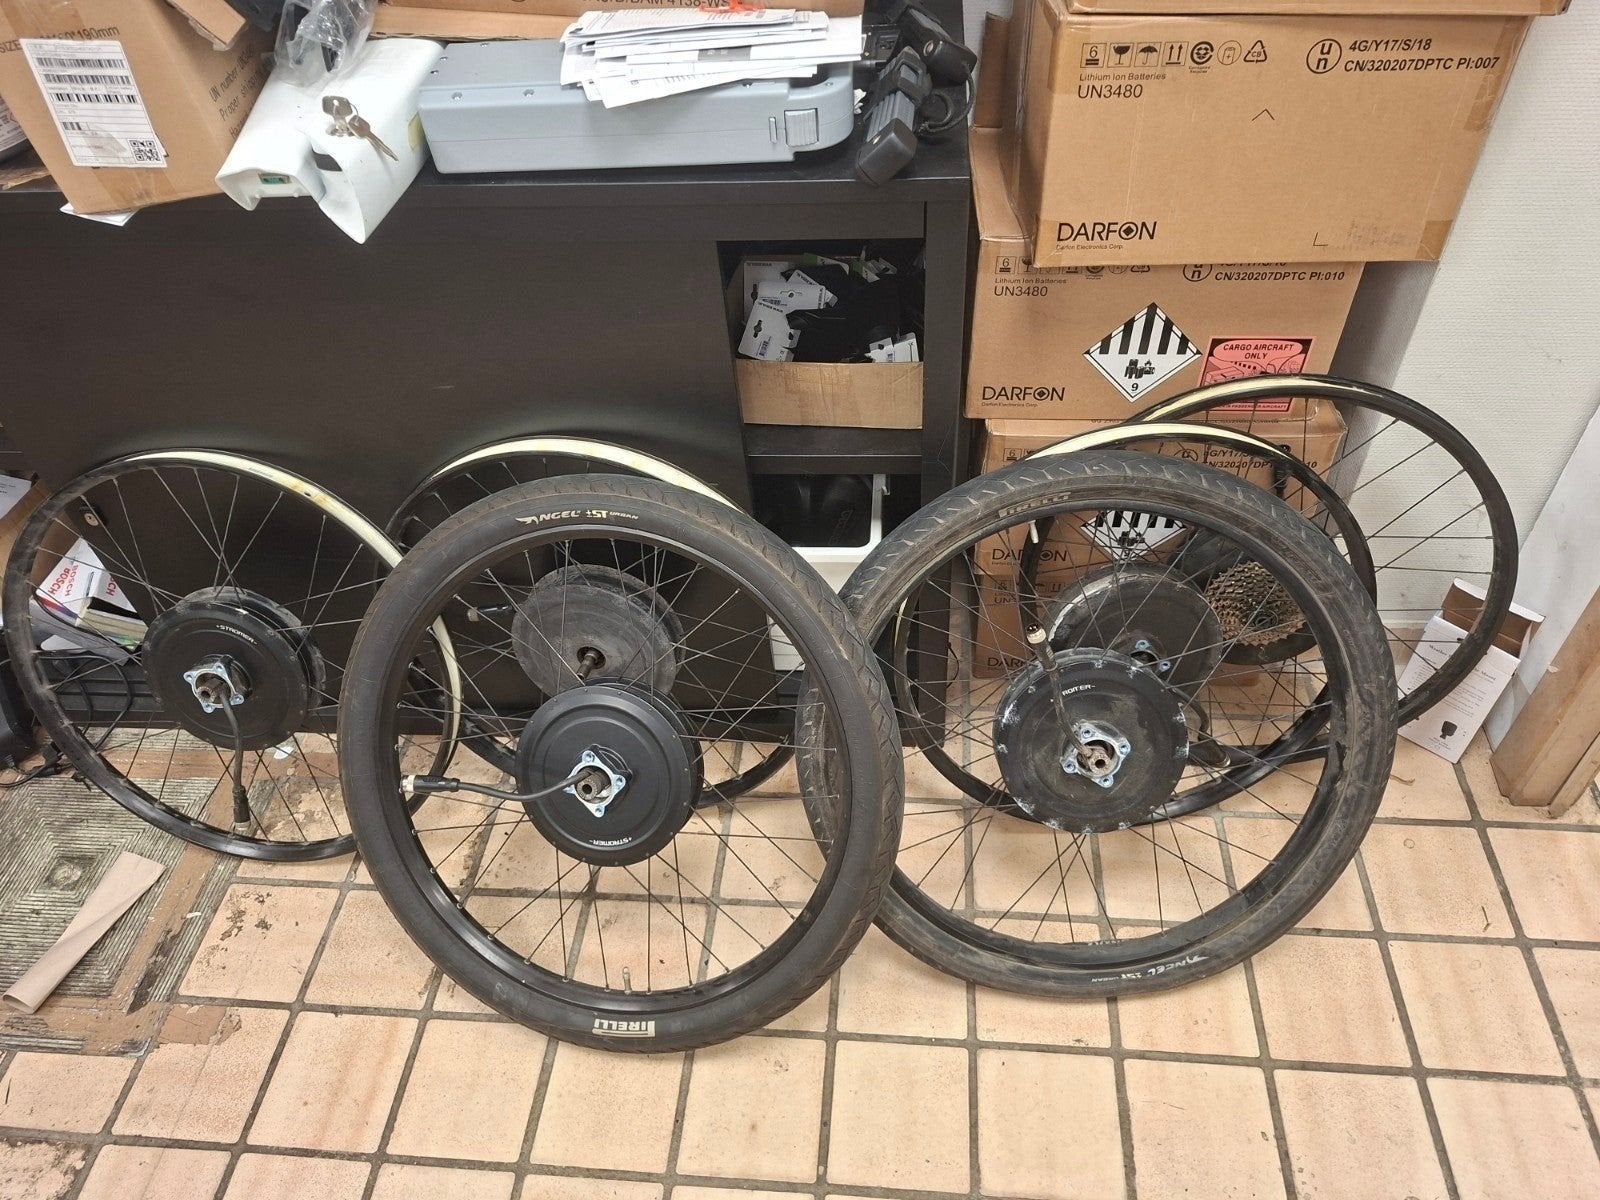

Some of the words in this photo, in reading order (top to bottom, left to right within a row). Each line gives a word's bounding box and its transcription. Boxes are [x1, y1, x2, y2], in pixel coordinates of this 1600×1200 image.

[1349, 38, 1432, 52] 4G/Y17/S/18
[1344, 58, 1453, 72] CN/320207DPTC
[1456, 56, 1500, 70] PI:007
[1079, 72, 1111, 81] Lithium
[1112, 72, 1126, 81] Ion
[1128, 72, 1166, 81] Batteries
[1078, 84, 1143, 99] UN3480
[1057, 221, 1158, 242] DARFON
[1215, 271, 1307, 281] CN/320207DPTC
[1309, 271, 1345, 281] PI:010
[993, 285, 1048, 297] UN3480
[1223, 343, 1252, 351] CARGO
[1254, 343, 1294, 351] AIRCRAFT
[1244, 352, 1268, 360] ONLY
[982, 386, 1065, 401] DARFON
[1130, 382, 1140, 392] 9
[592, 1018, 656, 1038] PIRELLI
